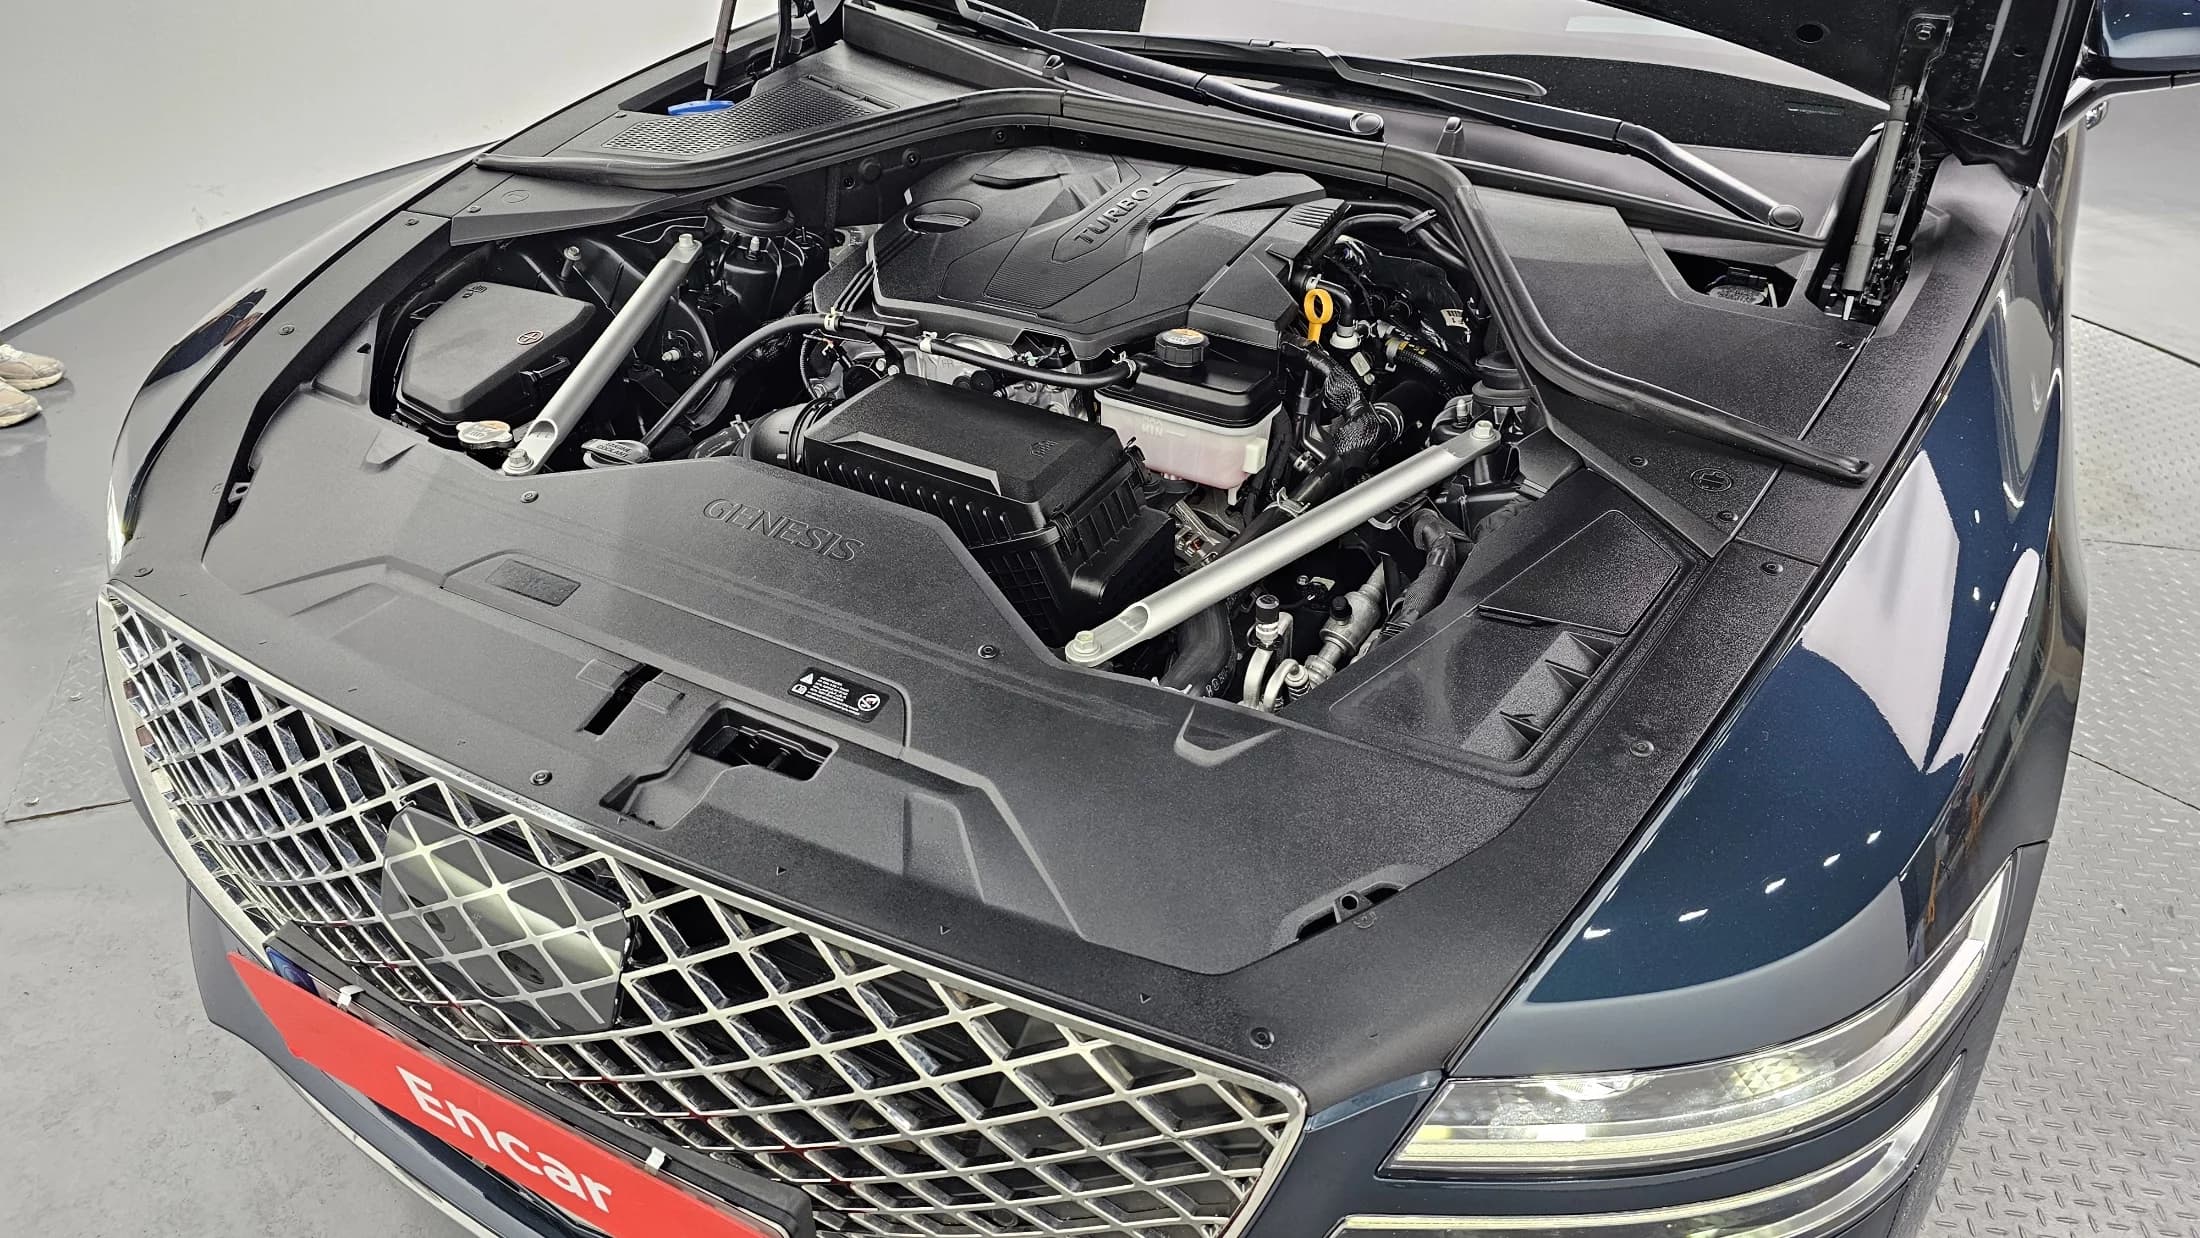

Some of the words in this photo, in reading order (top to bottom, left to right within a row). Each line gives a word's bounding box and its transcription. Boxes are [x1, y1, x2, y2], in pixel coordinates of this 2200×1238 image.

[1074, 187, 1153, 245] TURBO
[702, 498, 865, 562] GENESIS
[396, 1065, 612, 1213] Encar
